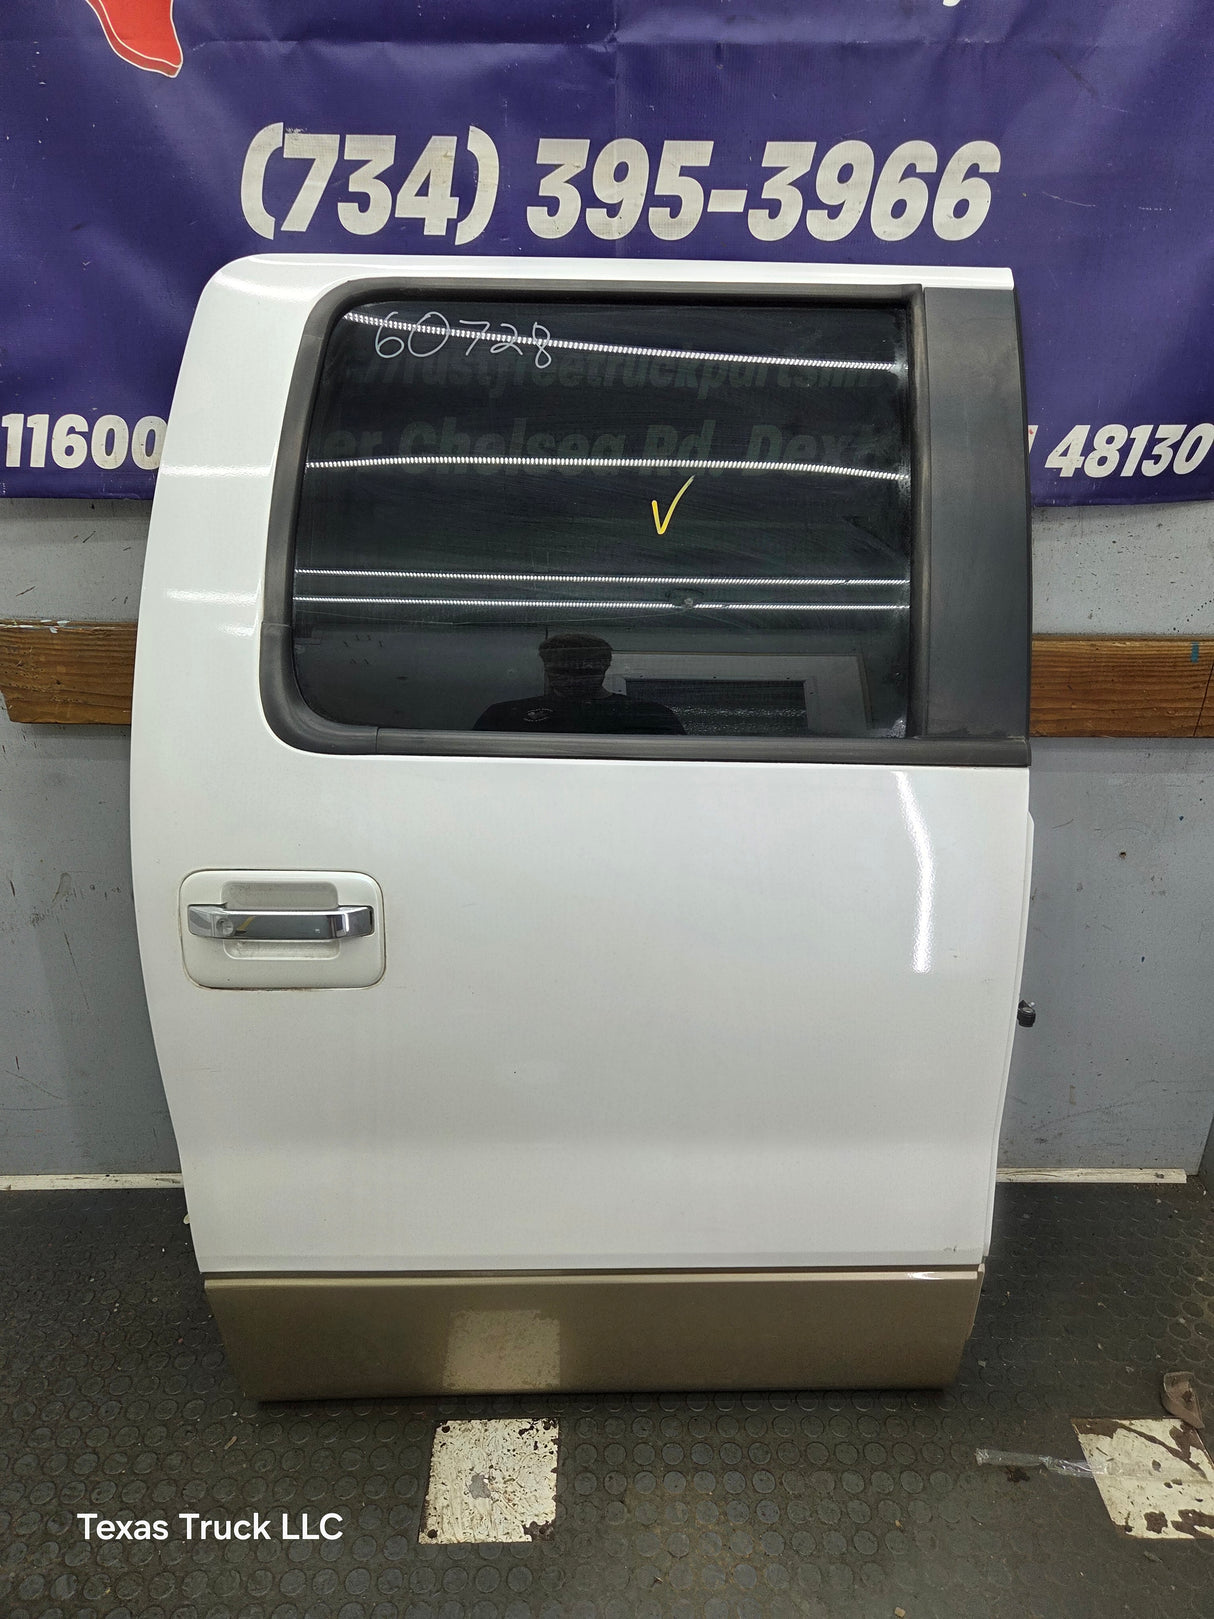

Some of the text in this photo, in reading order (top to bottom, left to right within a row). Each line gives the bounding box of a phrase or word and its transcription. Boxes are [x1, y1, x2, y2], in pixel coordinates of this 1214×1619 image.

[241, 122, 1001, 245] (734) 395-3966
[375, 311, 551, 368] 60728
[1, 413, 168, 470] 11600
[1045, 423, 1214, 478] 48130
